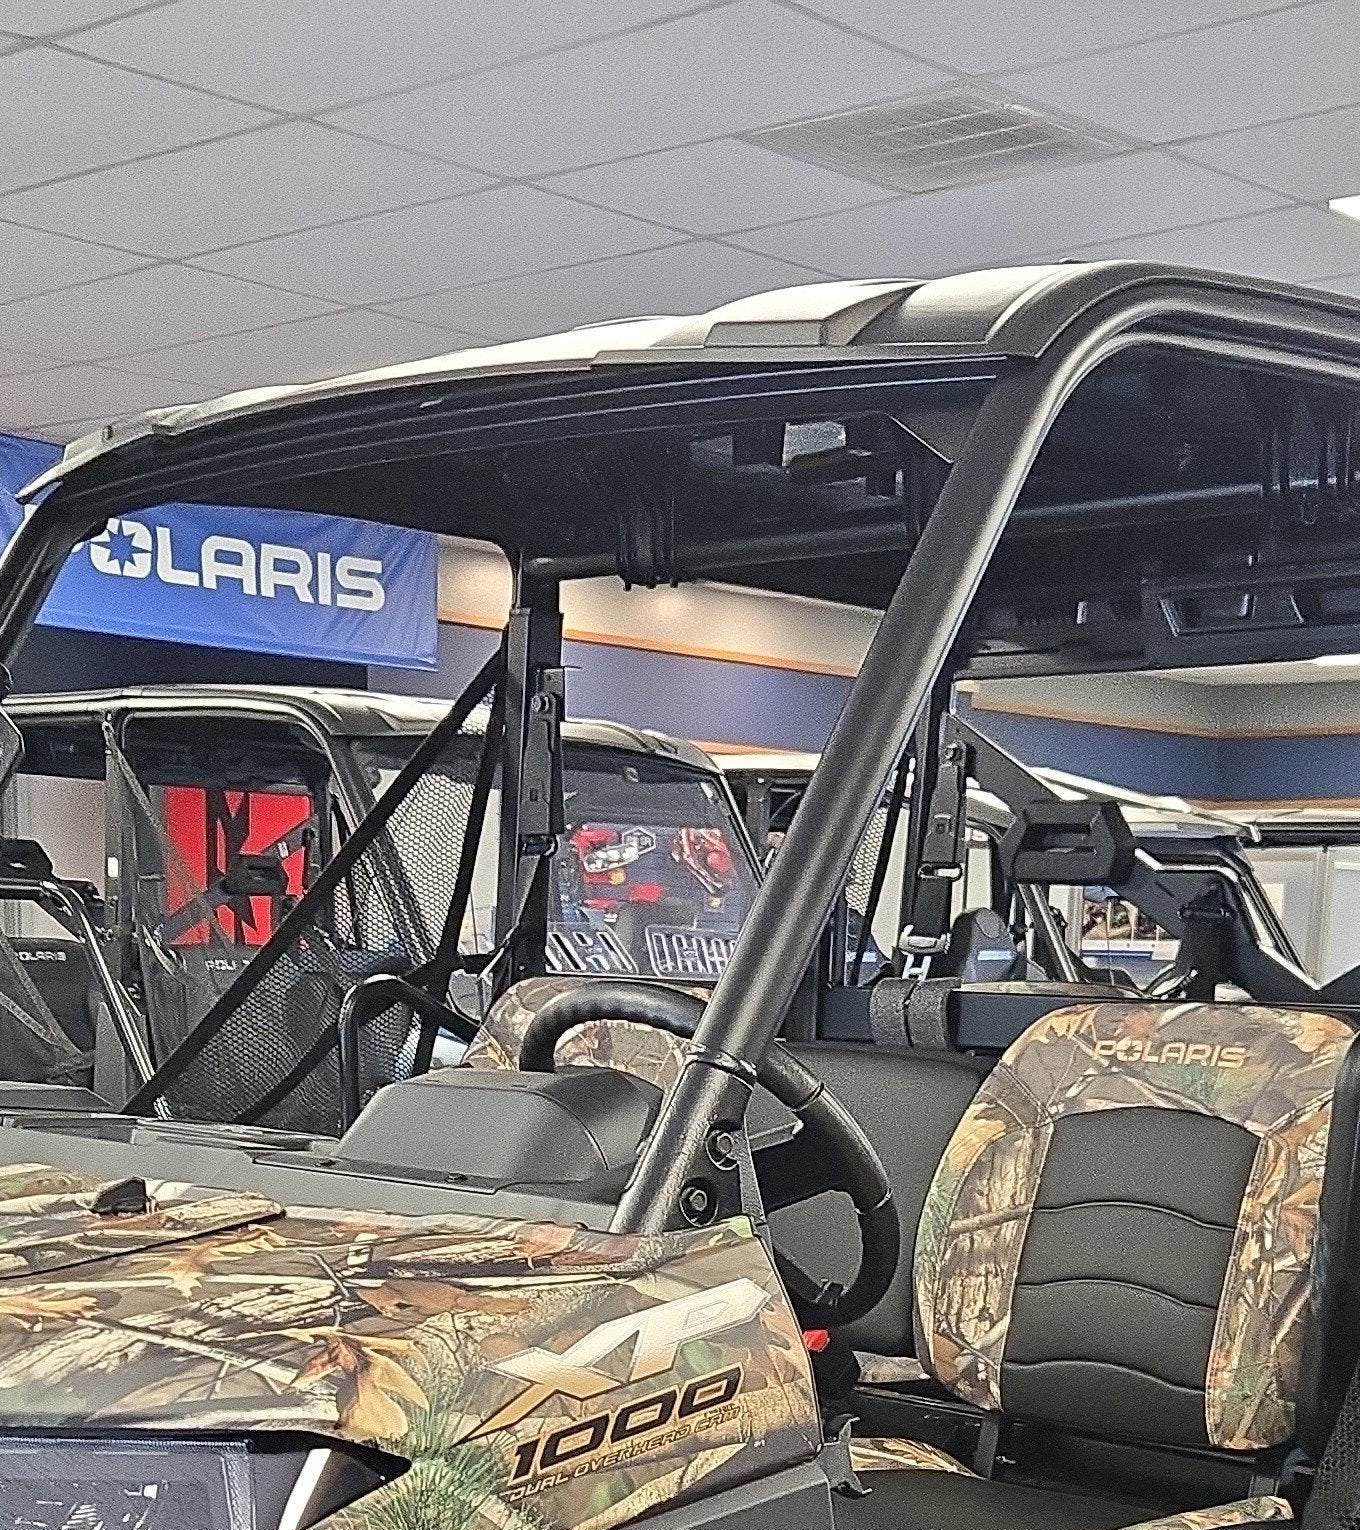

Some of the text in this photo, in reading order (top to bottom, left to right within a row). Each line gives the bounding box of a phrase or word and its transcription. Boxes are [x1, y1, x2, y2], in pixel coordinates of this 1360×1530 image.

[24, 503, 386, 612] OLARIS
[14, 951, 67, 961] OLARIS
[1094, 1038, 1248, 1069] POLARIS
[451, 1277, 771, 1447] XP
[508, 1362, 745, 1486] 1000
[510, 1404, 741, 1501] DUAL OVERHEAD CAM
